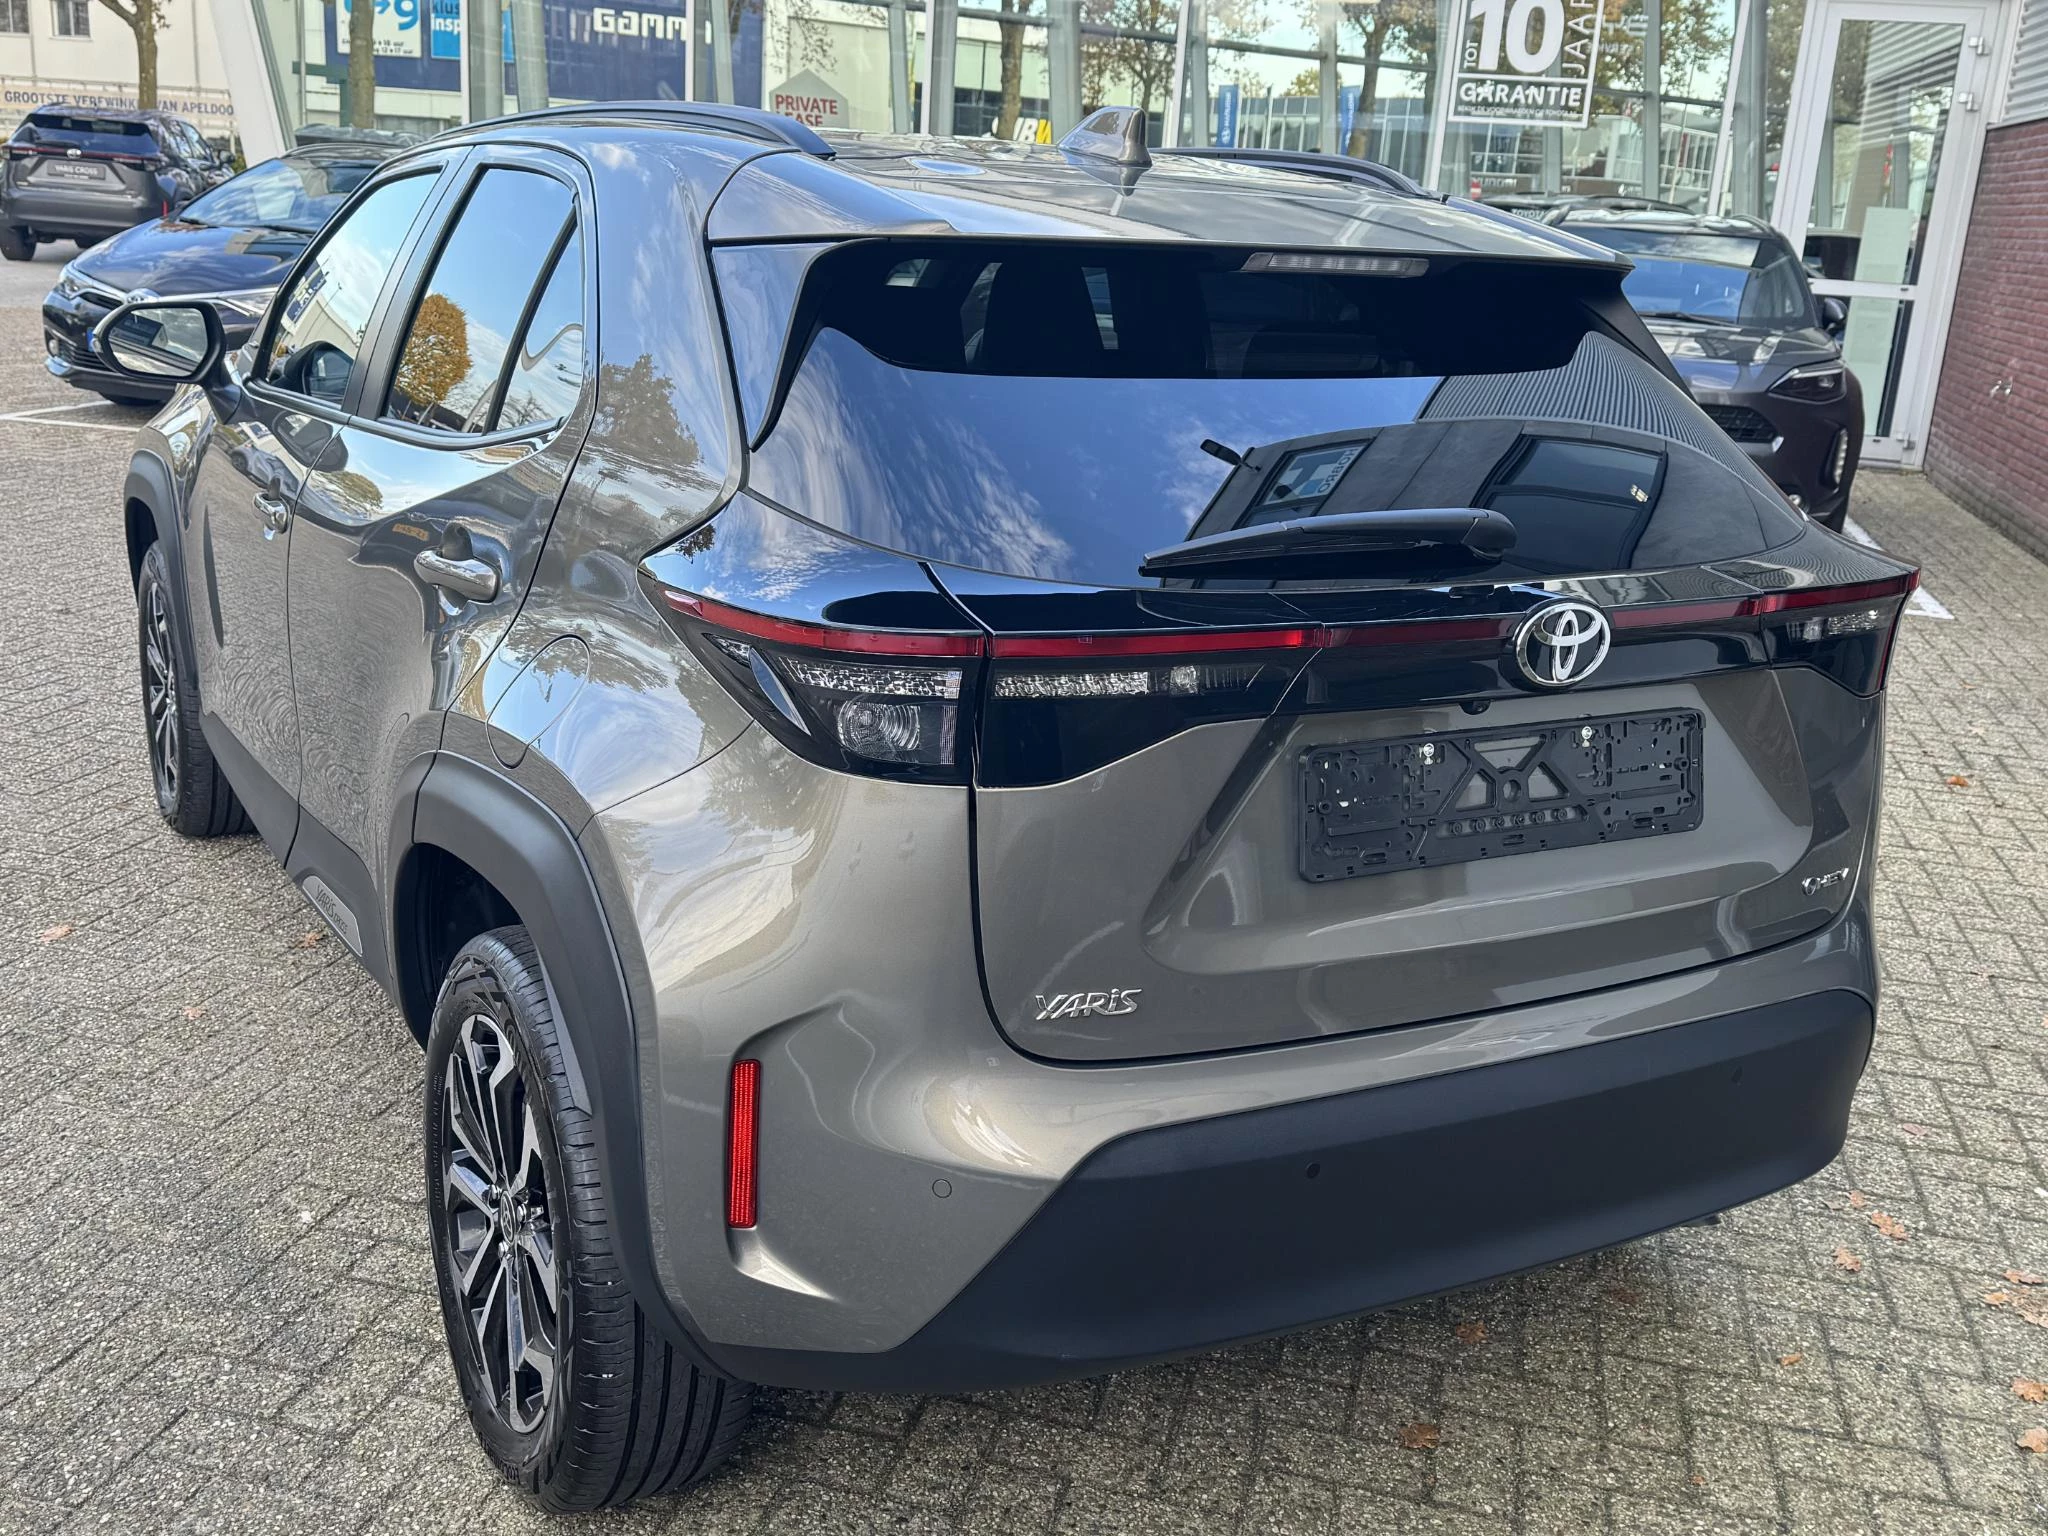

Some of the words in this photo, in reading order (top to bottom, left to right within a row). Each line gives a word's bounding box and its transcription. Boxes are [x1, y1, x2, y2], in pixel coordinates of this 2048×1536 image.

[1470, 0, 1565, 73] 10
[1464, 40, 1478, 69] TOT
[4, 90, 69, 104] GROOTSTE
[775, 94, 838, 115] PRIVATE
[1459, 82, 1582, 107] GARANTIE
